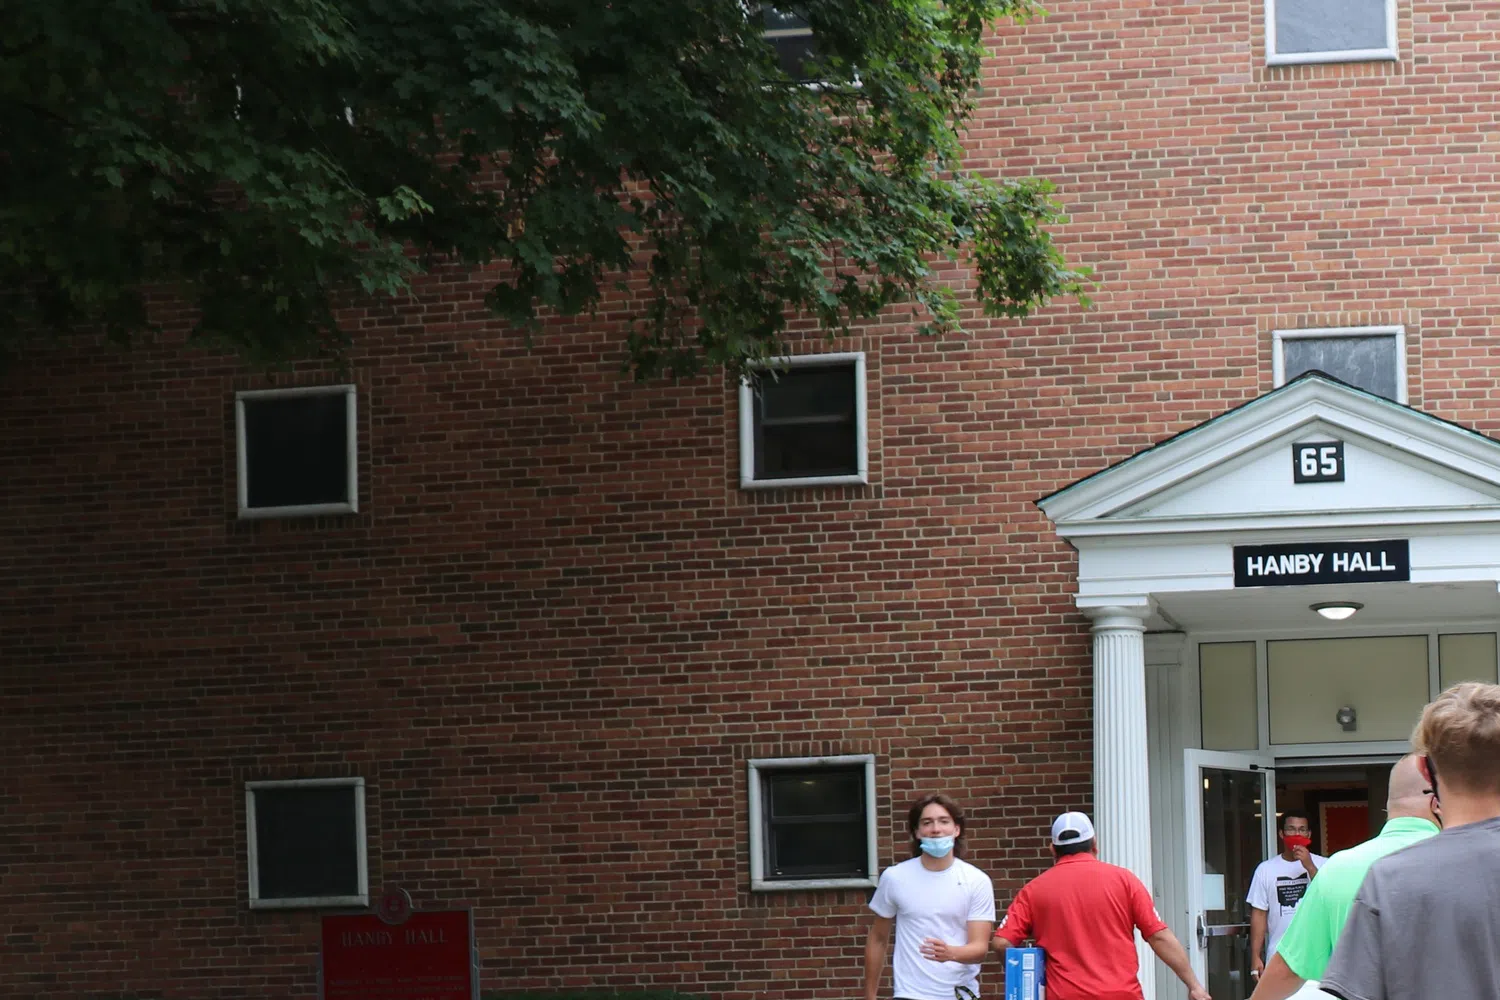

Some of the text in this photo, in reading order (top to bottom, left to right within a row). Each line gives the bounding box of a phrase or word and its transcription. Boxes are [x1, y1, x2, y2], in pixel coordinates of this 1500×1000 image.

[1300, 446, 1338, 477] 65
[1247, 551, 1396, 576] HANBY HALL
[404, 927, 448, 945] HALL
